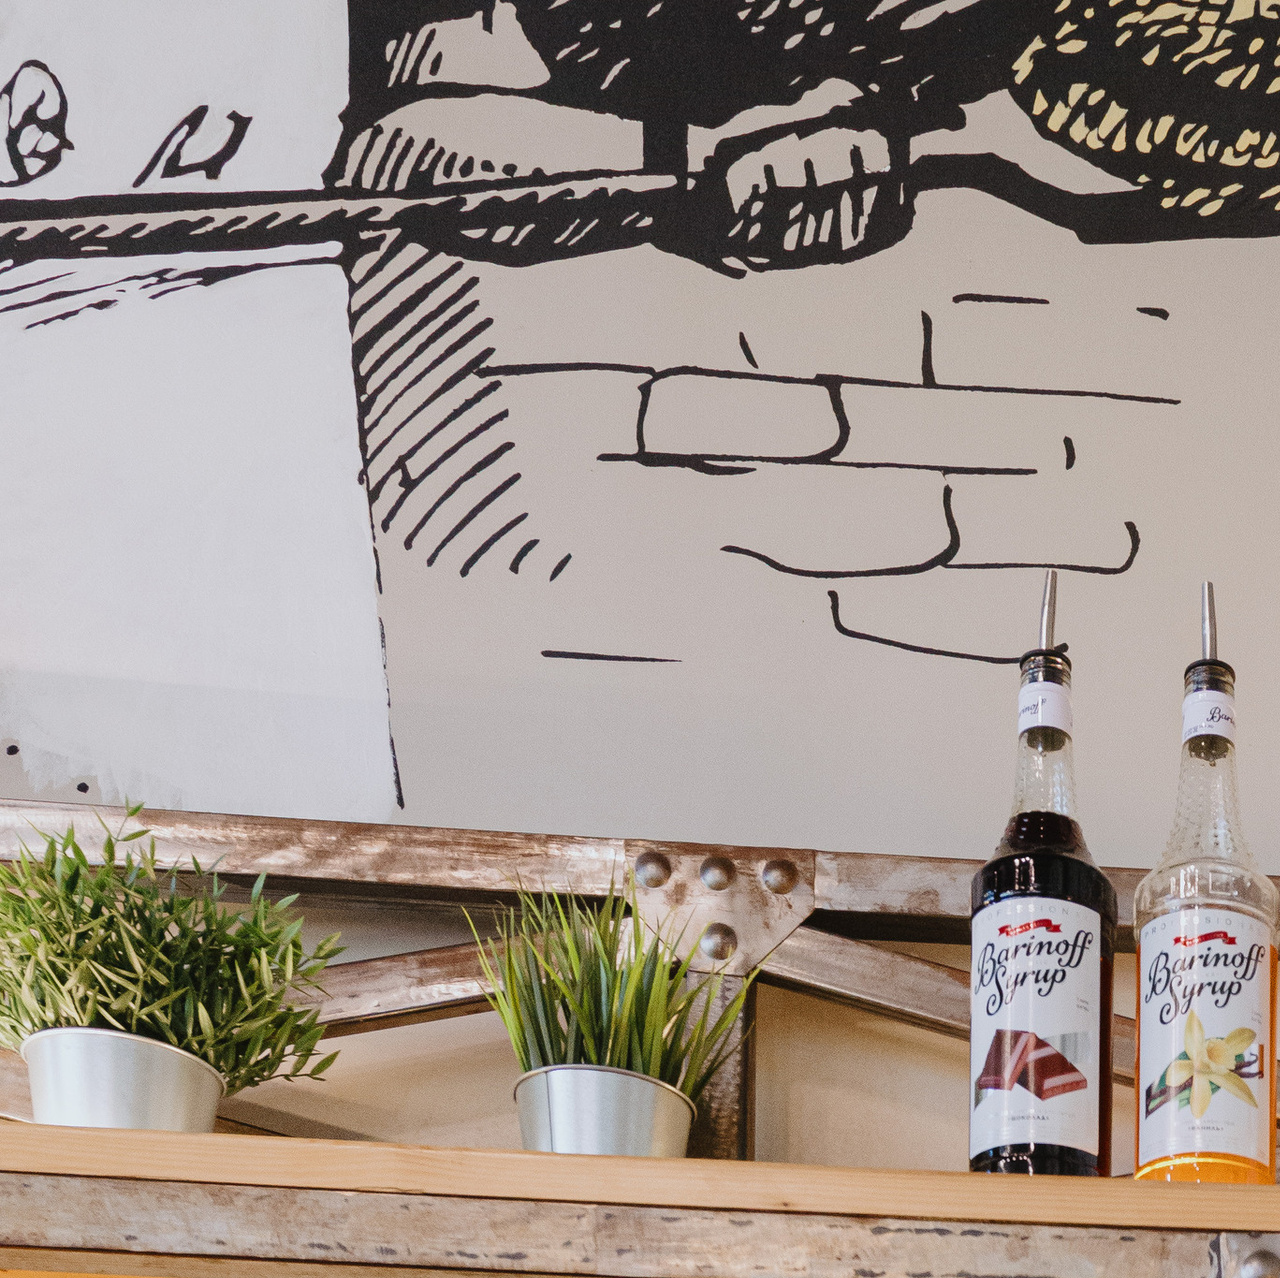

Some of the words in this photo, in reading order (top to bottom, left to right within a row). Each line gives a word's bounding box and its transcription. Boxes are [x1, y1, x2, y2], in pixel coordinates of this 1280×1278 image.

[974, 929, 1094, 996] Barinoff
[986, 963, 1067, 1016] Syrup
[1145, 943, 1266, 1004] Barinoff
[1159, 974, 1243, 1025] Syrup
